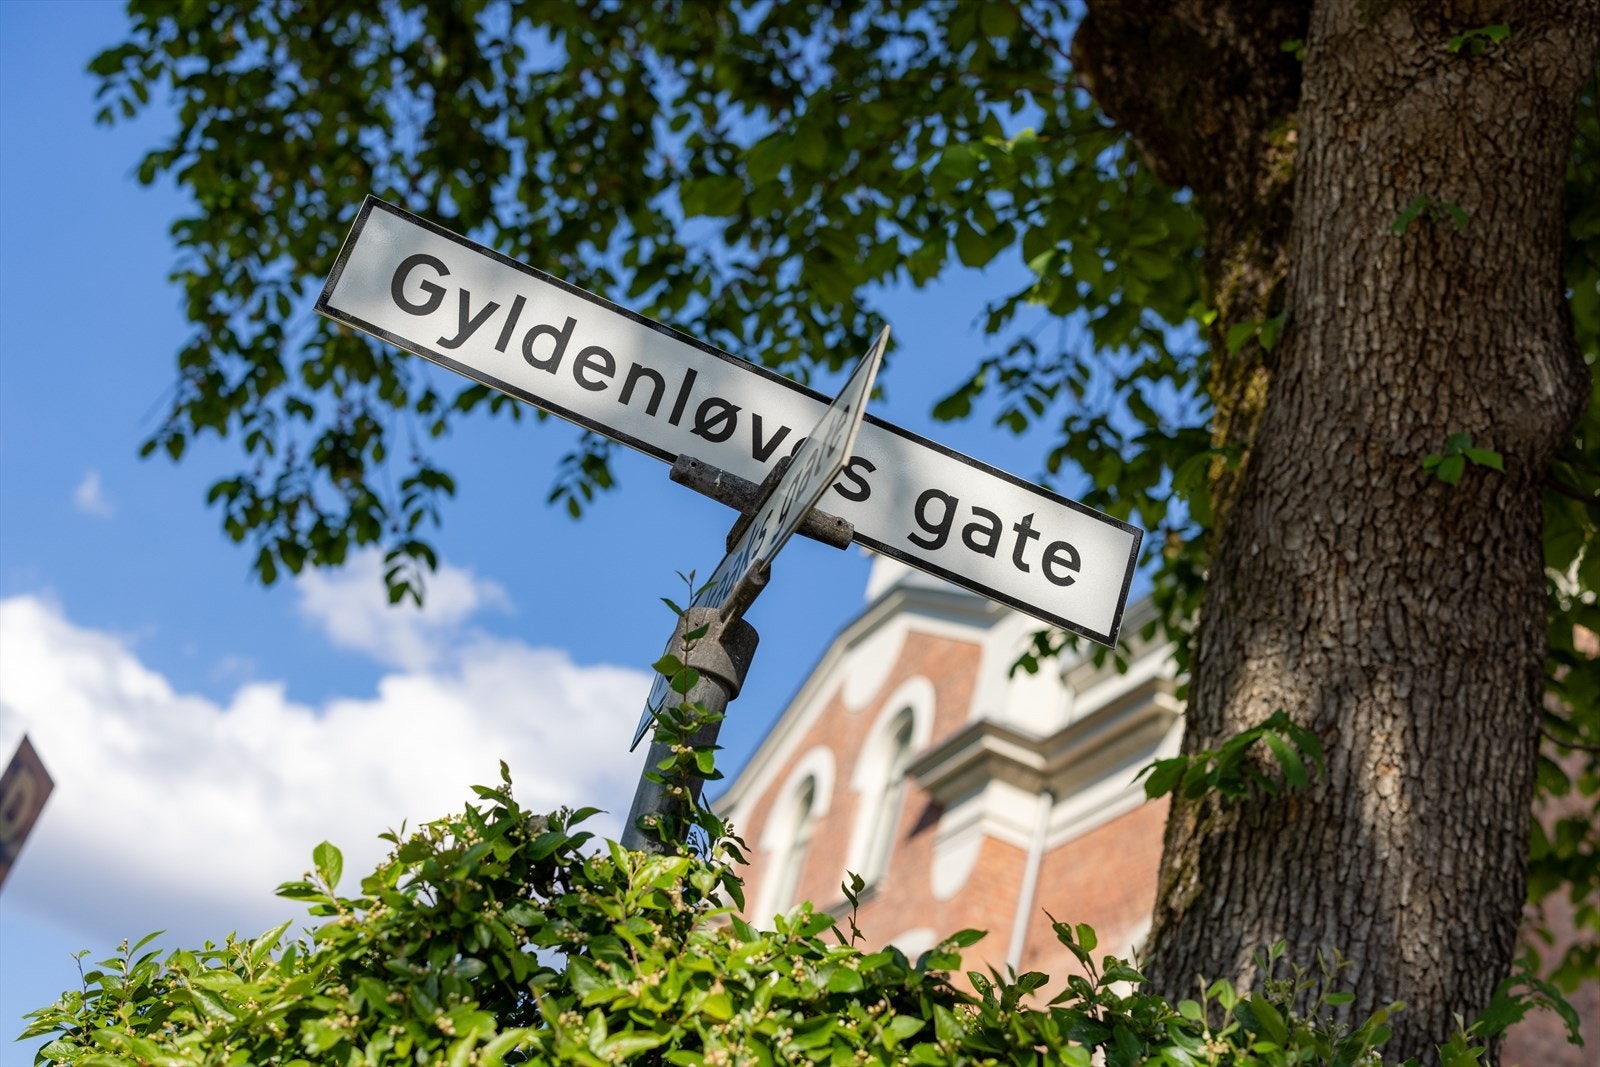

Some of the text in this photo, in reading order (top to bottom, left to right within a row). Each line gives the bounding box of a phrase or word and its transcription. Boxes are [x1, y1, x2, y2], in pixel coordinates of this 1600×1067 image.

[391, 253, 1081, 587] Gyldenløvs gate
[771, 404, 850, 546] gate
